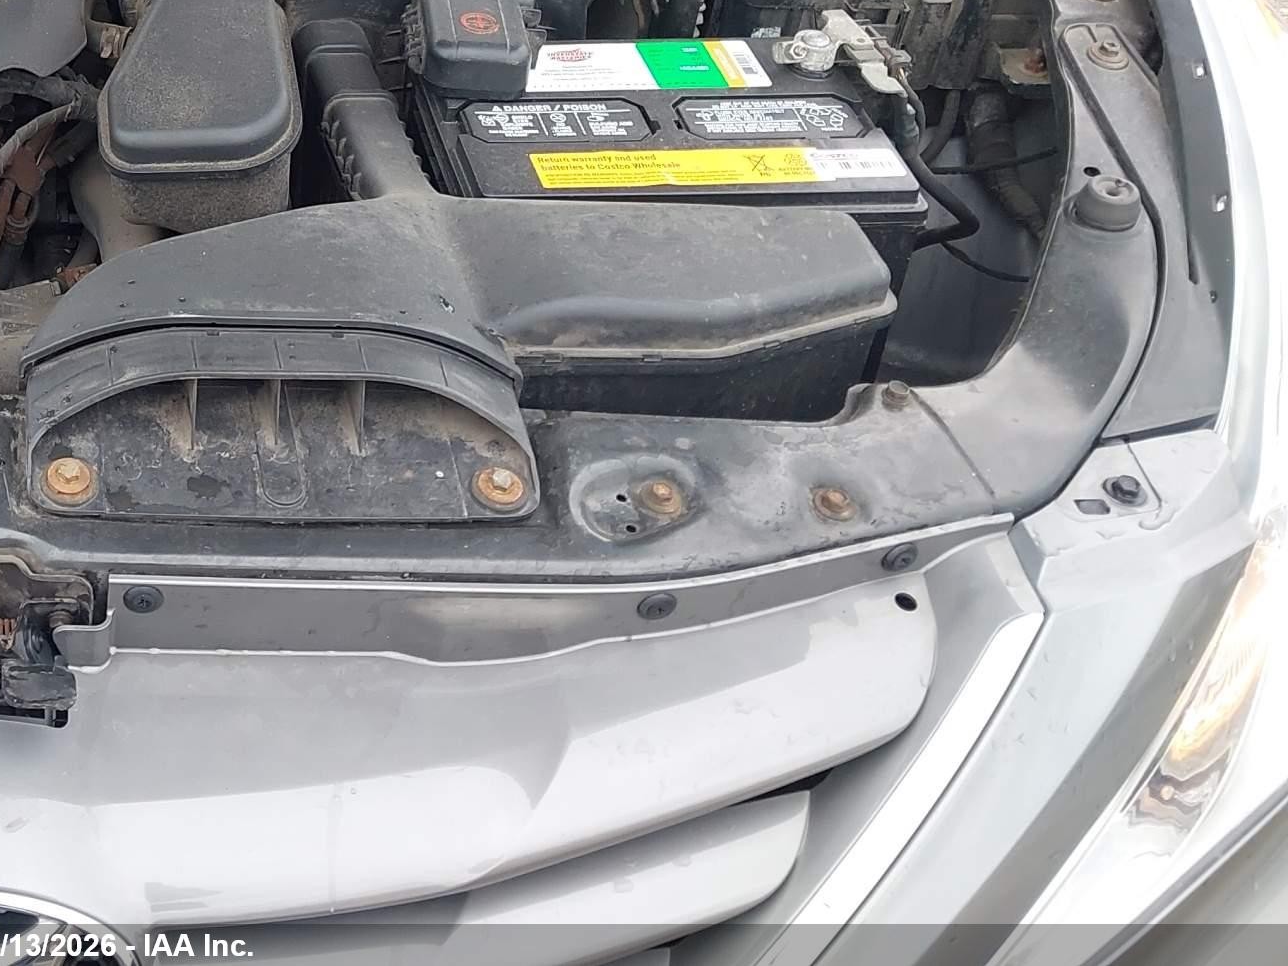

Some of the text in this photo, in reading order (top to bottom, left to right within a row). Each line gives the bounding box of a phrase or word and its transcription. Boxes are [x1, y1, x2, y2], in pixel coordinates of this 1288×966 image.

[562, 103, 607, 111] POISON
[572, 155, 612, 163] warranty
[633, 162, 681, 170] Wholesale
